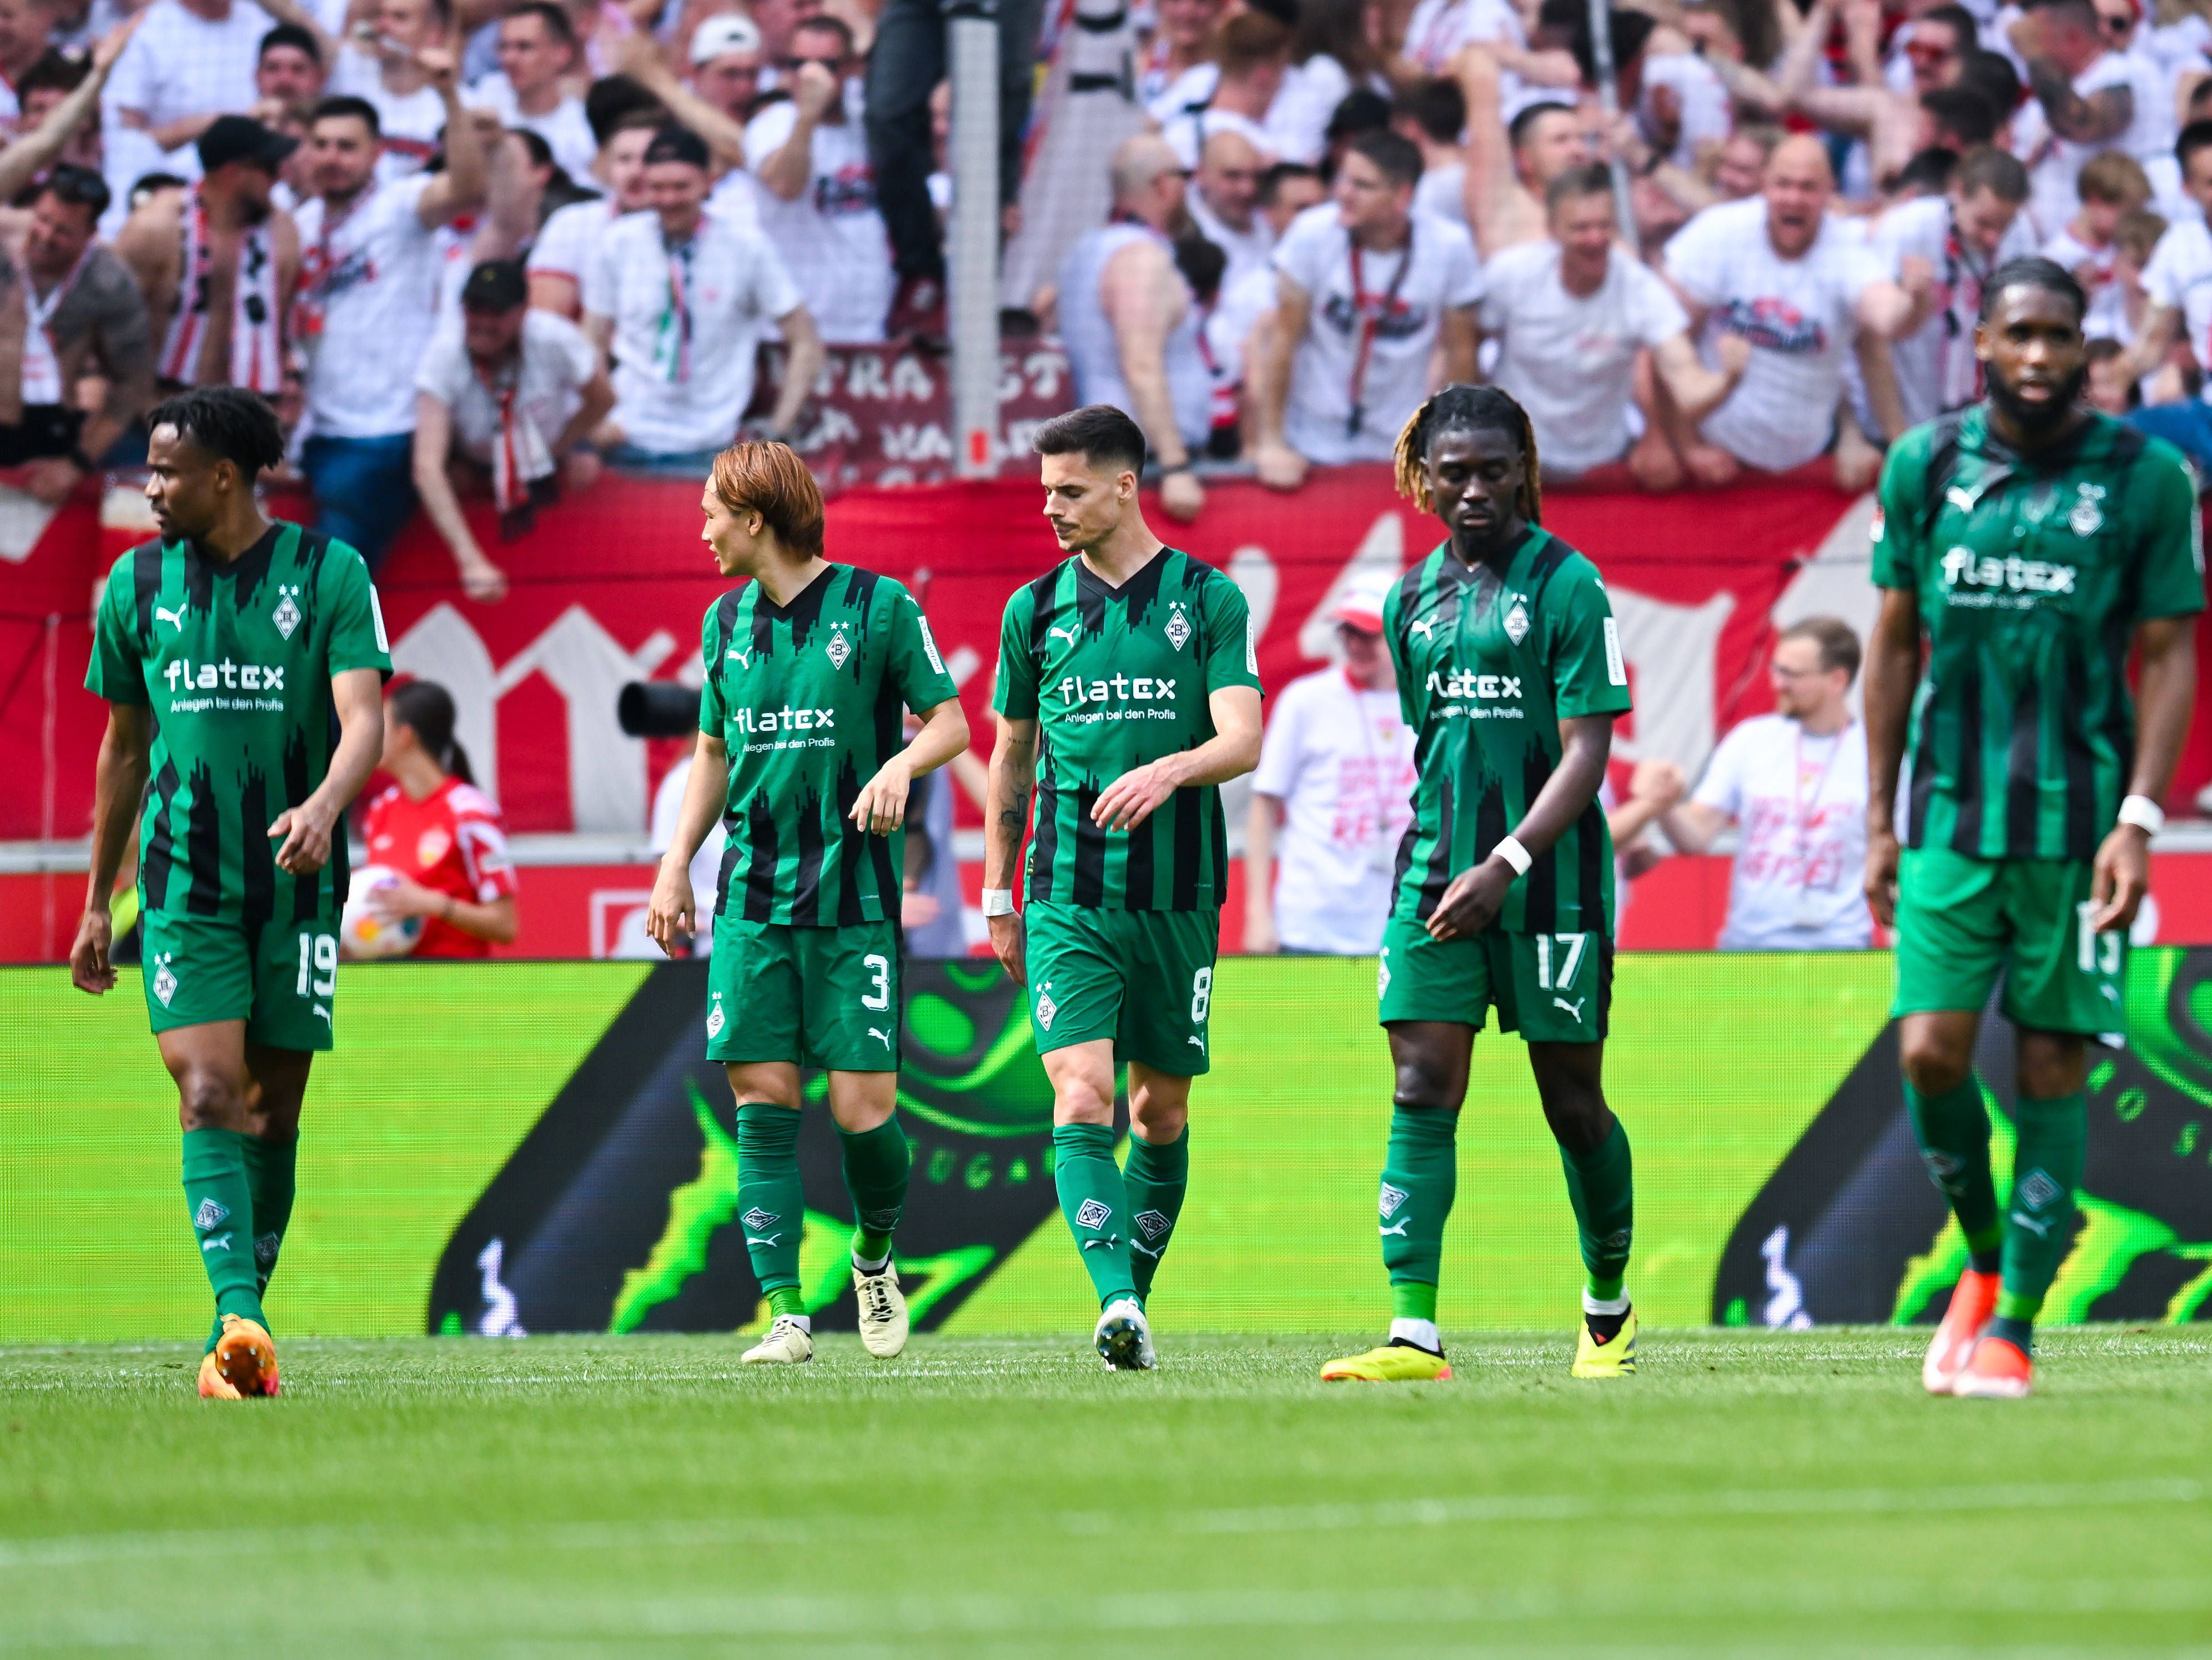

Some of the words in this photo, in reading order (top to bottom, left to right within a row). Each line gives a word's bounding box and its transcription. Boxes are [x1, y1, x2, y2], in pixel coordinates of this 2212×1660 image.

[1940, 544, 2078, 594] flatex
[164, 656, 284, 692] flatex
[1057, 672, 1176, 705] flatex
[232, 696, 253, 711] den
[255, 697, 284, 711] Profis
[733, 705, 834, 734] flatex
[1065, 712, 1104, 724] Anlegen
[1106, 709, 1122, 720] bei
[1124, 709, 1145, 720] den
[1148, 709, 1176, 720] Profis
[788, 739, 806, 749] den
[808, 738, 835, 747] Profis
[296, 932, 339, 997] 19
[1535, 932, 1589, 991] 17
[862, 954, 890, 1012] 3
[1192, 966, 1212, 1025] 8
